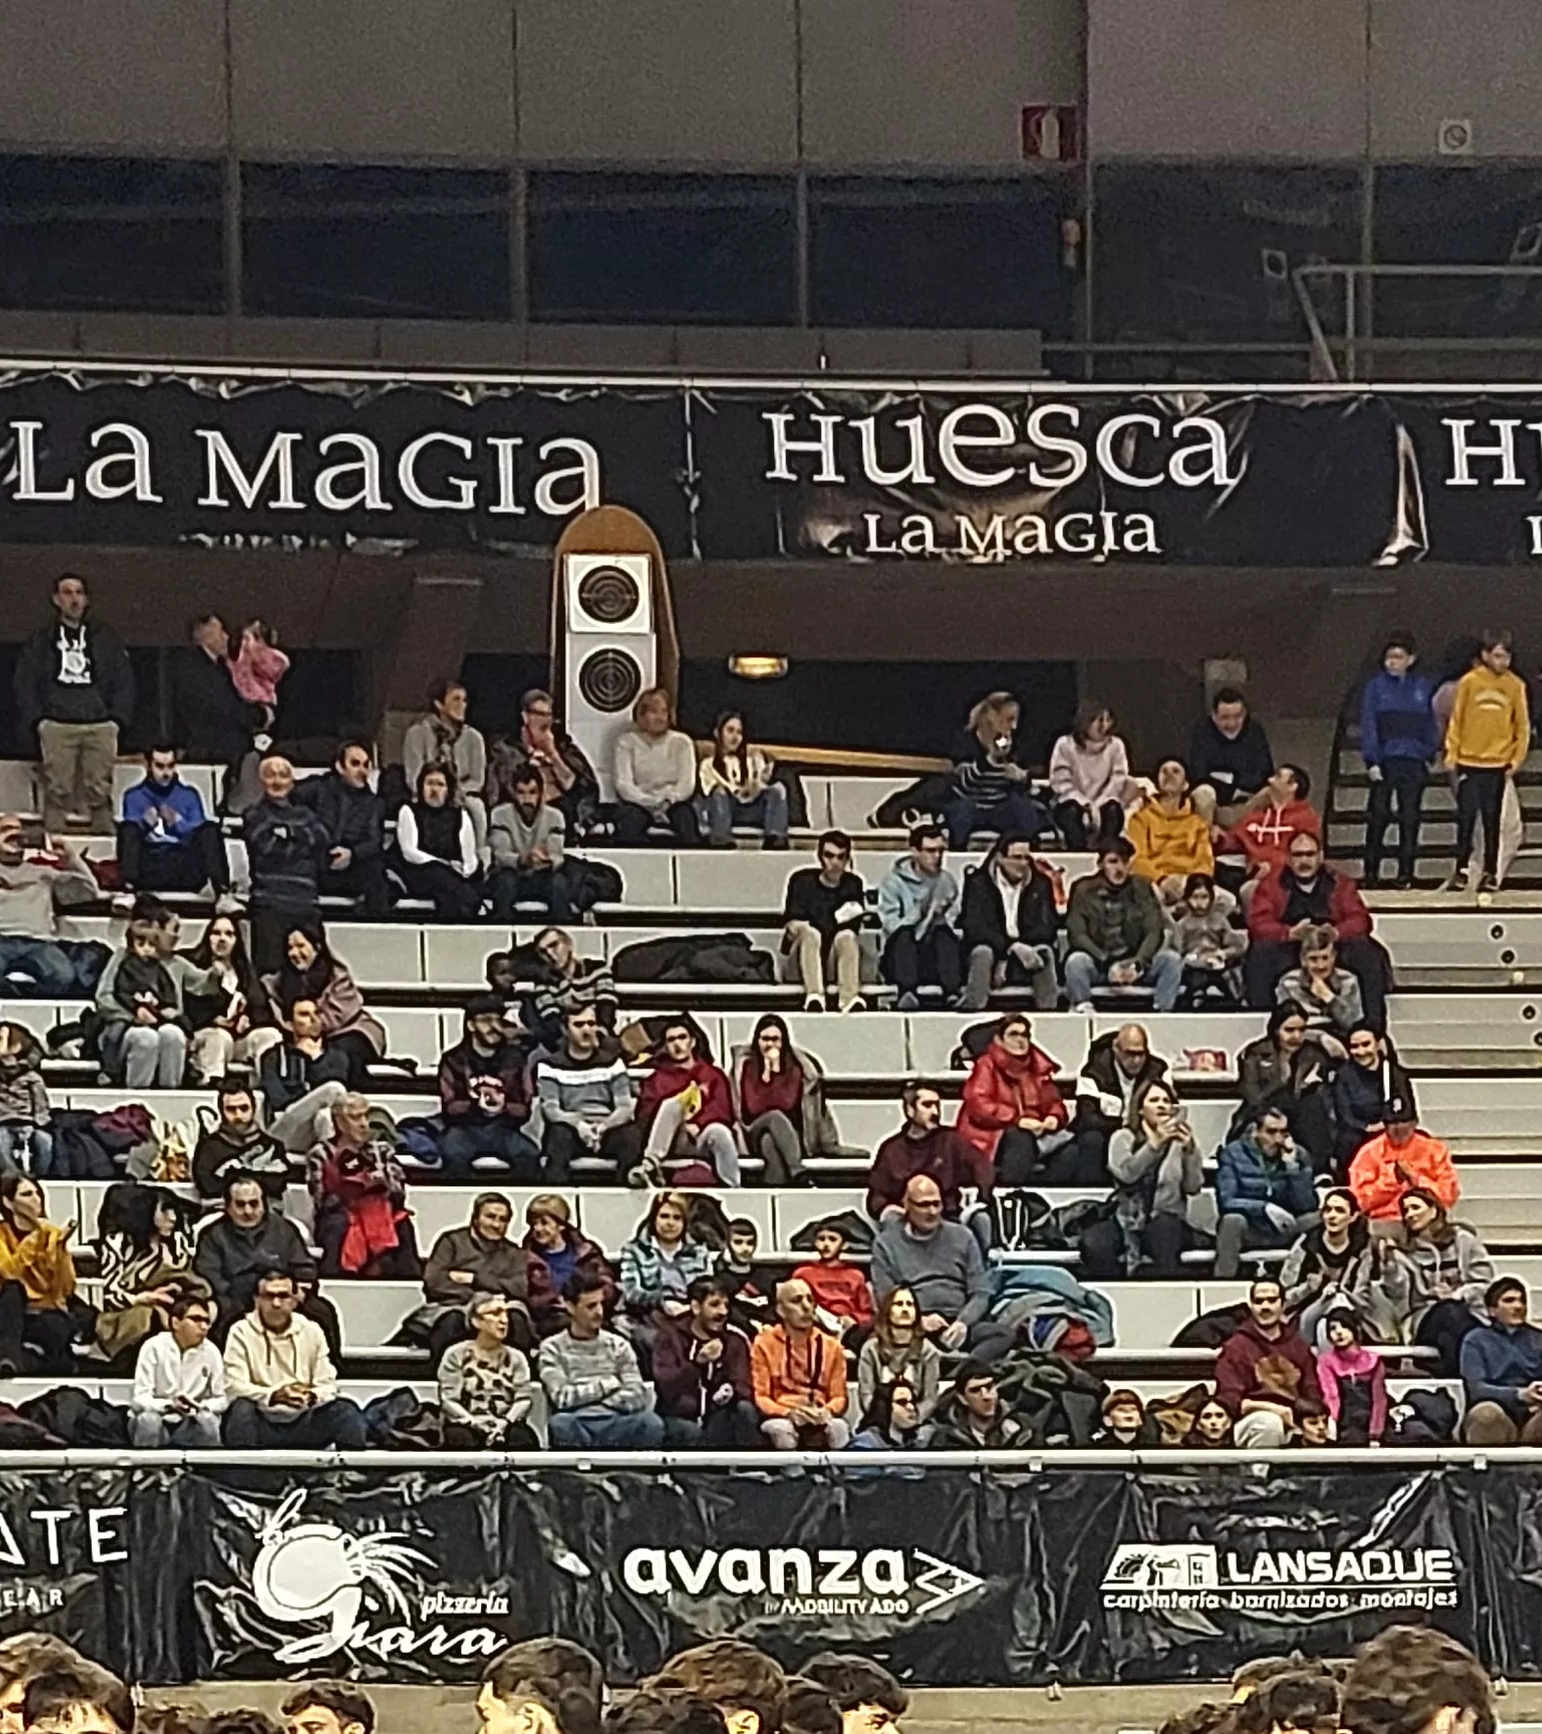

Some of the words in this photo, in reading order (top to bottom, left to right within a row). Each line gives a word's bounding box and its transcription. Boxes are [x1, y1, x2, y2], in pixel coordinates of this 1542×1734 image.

[623, 1546, 910, 1595] avanza
[1226, 1548, 1456, 1583] LANSAQUE
[420, 1590, 509, 1622] pizzeria
[869, 1597, 909, 1615] ADO
[1360, 1587, 1459, 1611] montajes
